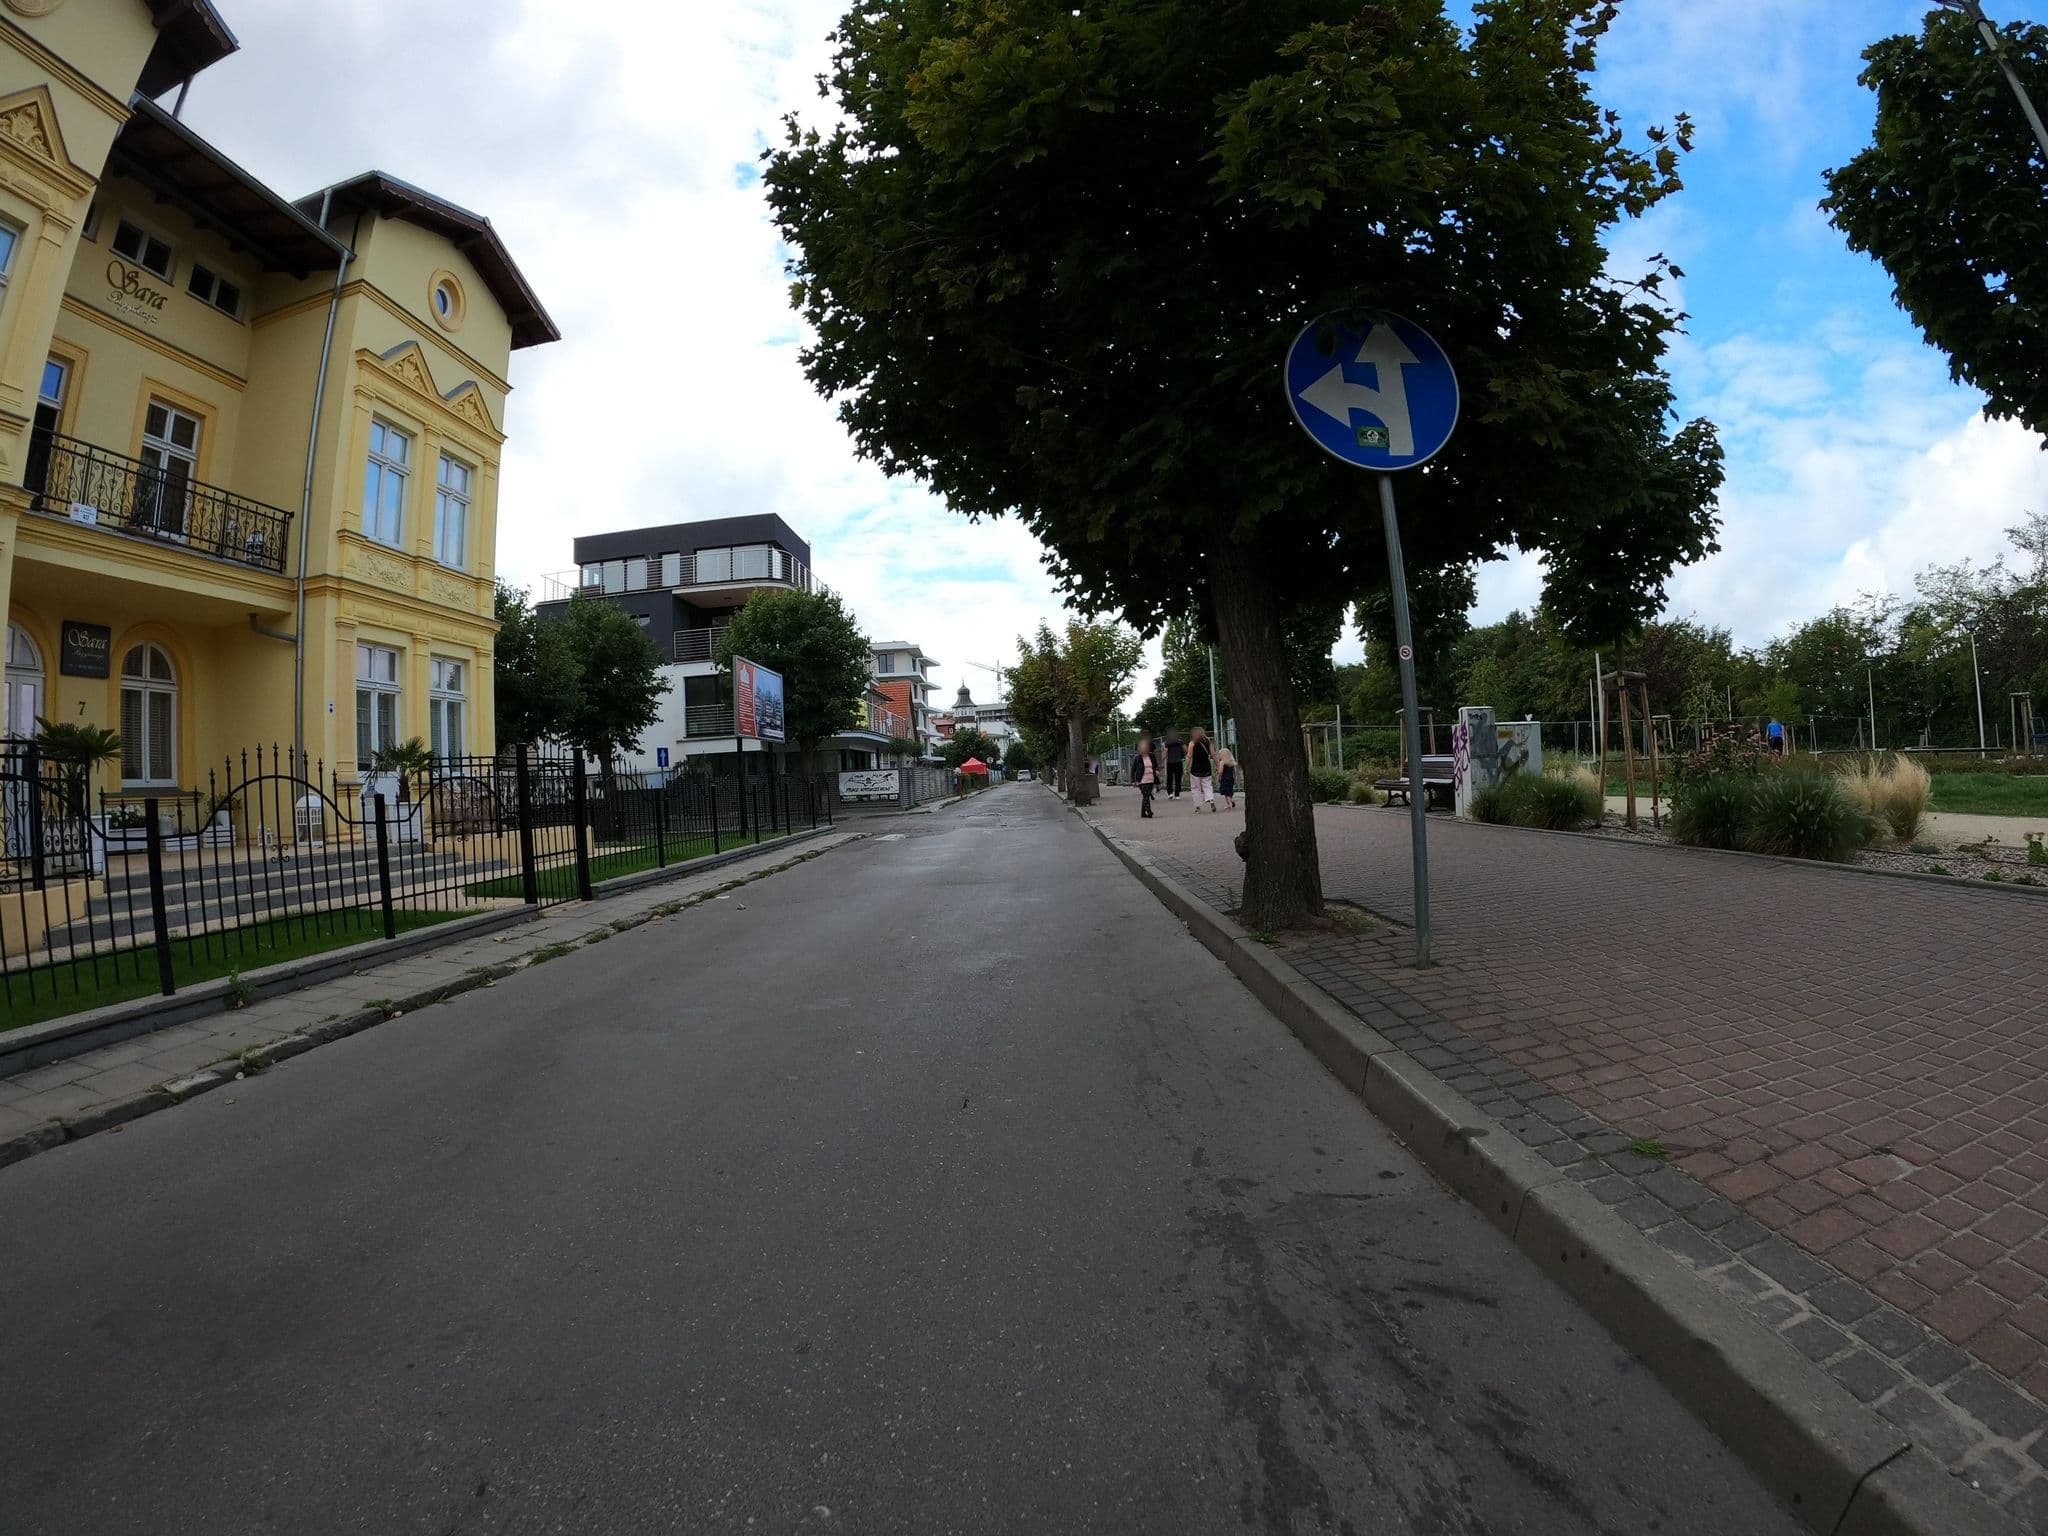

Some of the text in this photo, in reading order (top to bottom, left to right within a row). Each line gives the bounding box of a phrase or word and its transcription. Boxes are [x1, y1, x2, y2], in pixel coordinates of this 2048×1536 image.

[107, 260, 168, 310] Sara
[68, 628, 108, 650] Sara
[78, 700, 86, 716] 7
